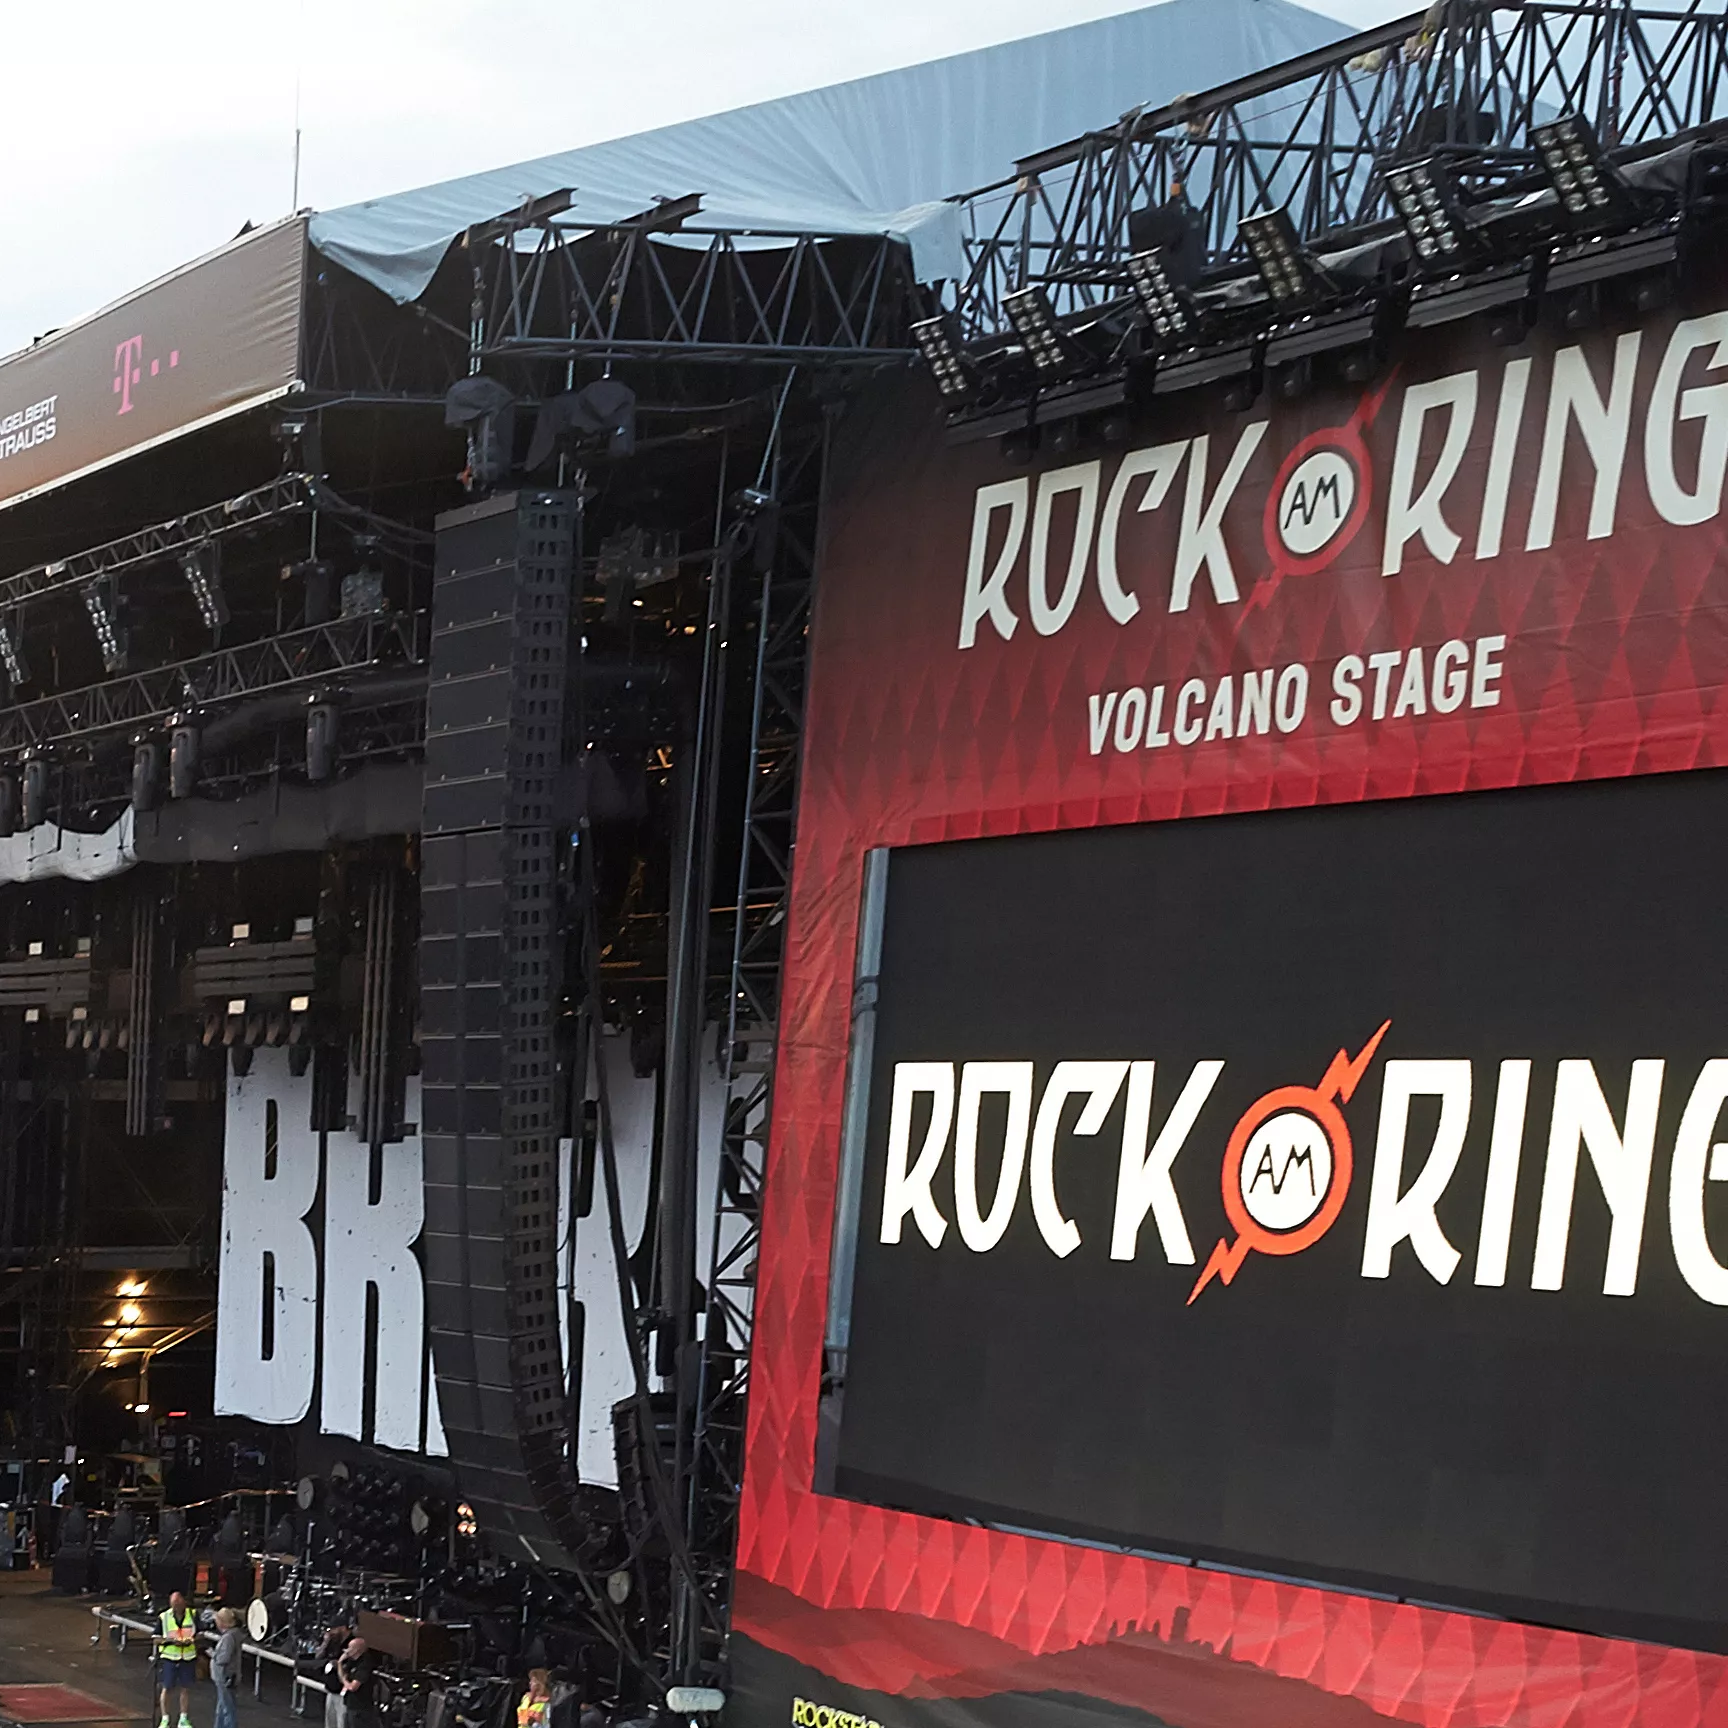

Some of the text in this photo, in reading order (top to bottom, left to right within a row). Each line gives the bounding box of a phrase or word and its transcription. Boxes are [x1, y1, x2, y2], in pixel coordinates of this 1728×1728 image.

[958, 311, 1728, 649] ROCK AM RING
[1088, 635, 1505, 756] VOLCANO STAGE
[879, 1060, 1225, 1265] ROCK
[1248, 1143, 1315, 1196] AM
